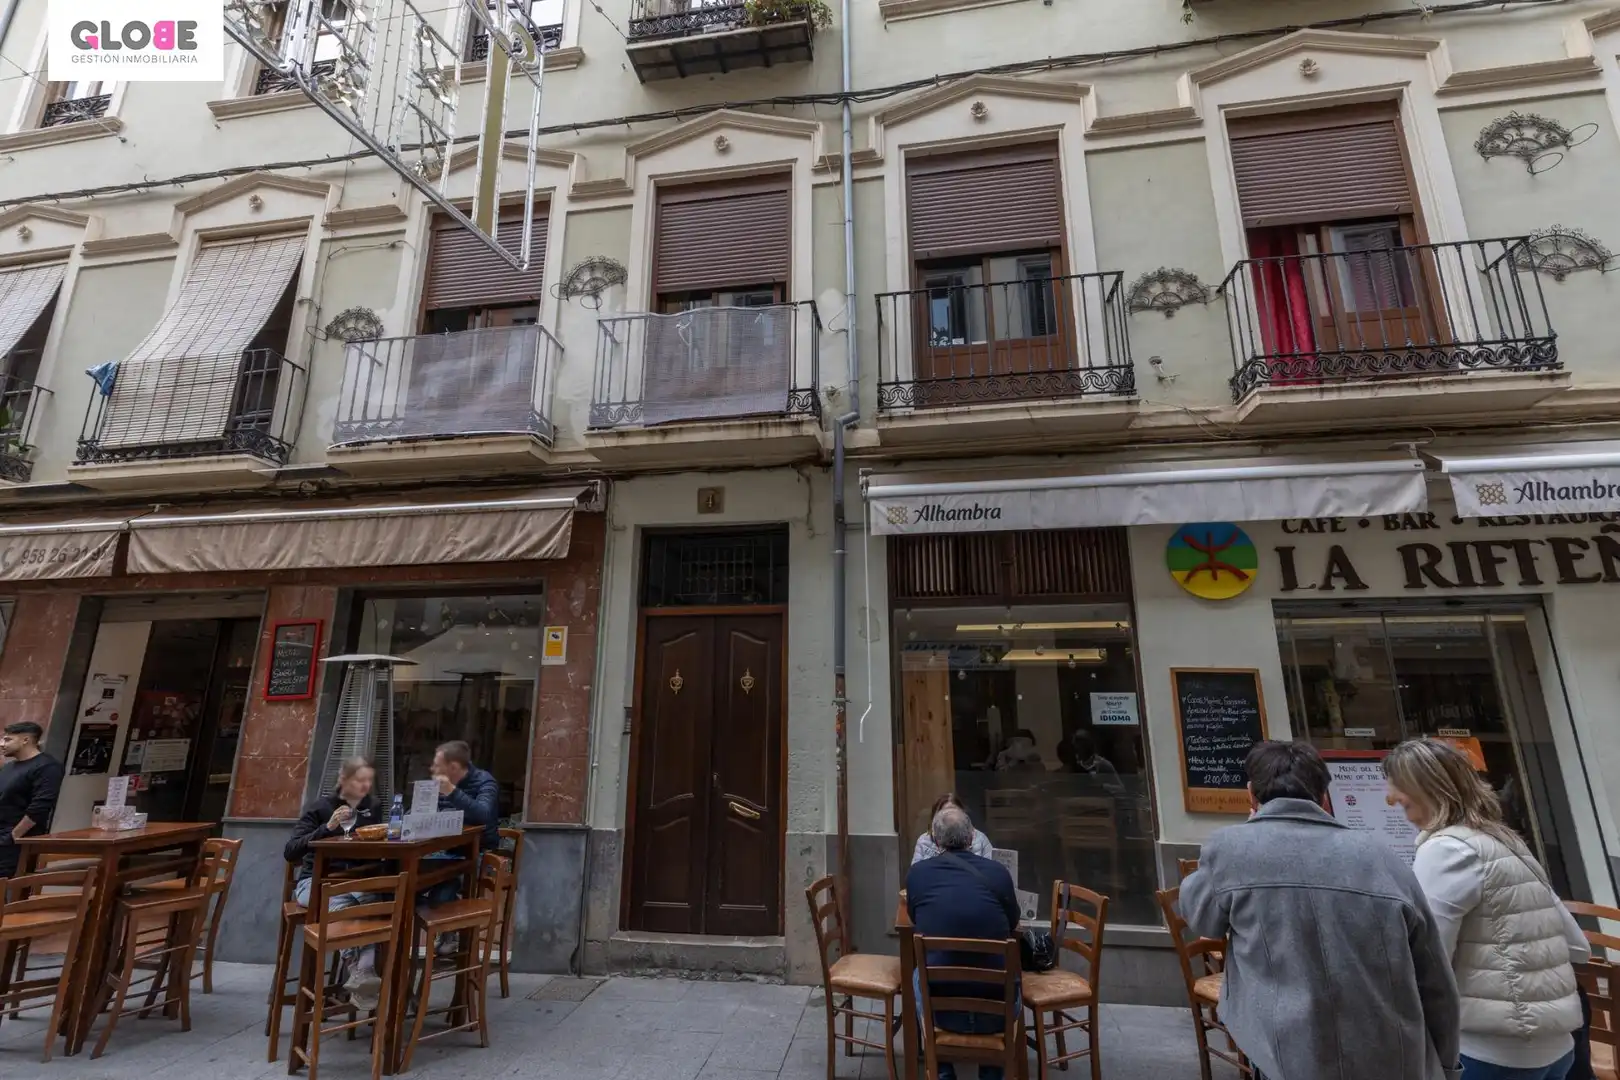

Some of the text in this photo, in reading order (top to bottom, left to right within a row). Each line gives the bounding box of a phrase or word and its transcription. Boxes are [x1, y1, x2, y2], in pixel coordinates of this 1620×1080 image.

[913, 502, 1001, 525] Alhambra
[1382, 511, 1440, 531] BAR
[20, 548, 46, 564] 958
[48, 547, 68, 563] 26
[1273, 545, 1369, 592] LA
[1100, 714, 1131, 722] IDIOMA
[1439, 729, 1468, 737] ENTRADA
